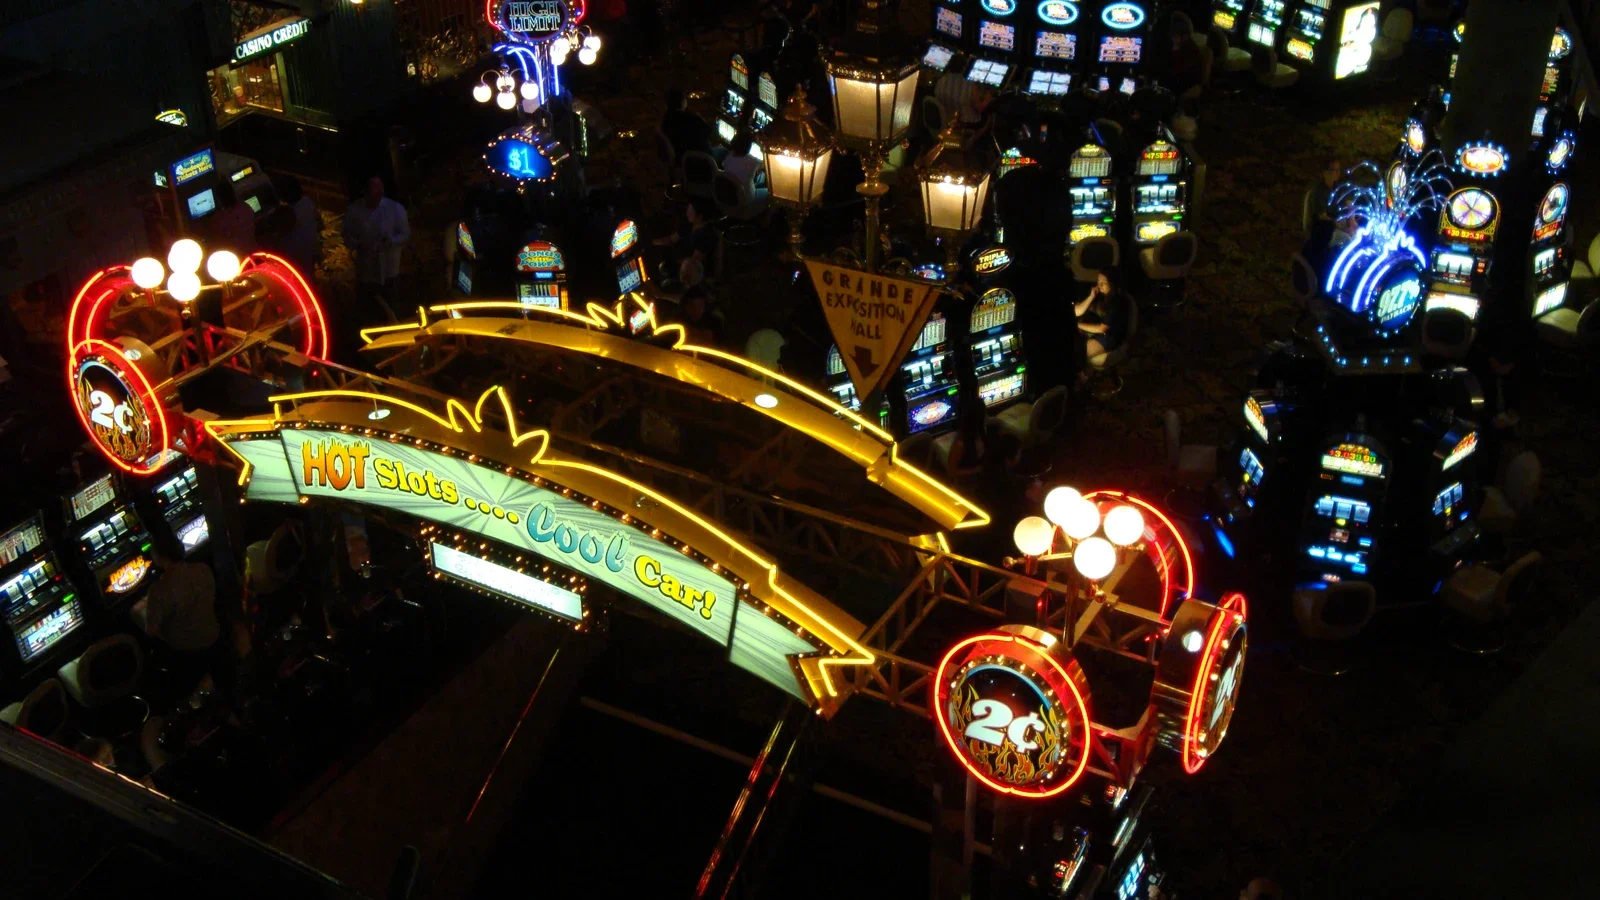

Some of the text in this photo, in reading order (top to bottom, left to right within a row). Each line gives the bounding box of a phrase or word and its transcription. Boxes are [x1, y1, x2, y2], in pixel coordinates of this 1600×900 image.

[509, 1, 558, 16] HIGH
[510, 16, 560, 32] LIMIT
[235, 18, 309, 59] CASINO CREDIT
[509, 147, 535, 176] $1
[979, 250, 1006, 264] TRIPLE
[822, 270, 914, 304] GRANDE
[826, 292, 905, 323] EXPOSITION
[850, 320, 882, 340] HALL
[90, 389, 134, 435] 2¢
[302, 438, 370, 491] HOT
[526, 500, 632, 573] Cool
[634, 554, 717, 620] Car!
[965, 698, 1046, 754] 2¢
